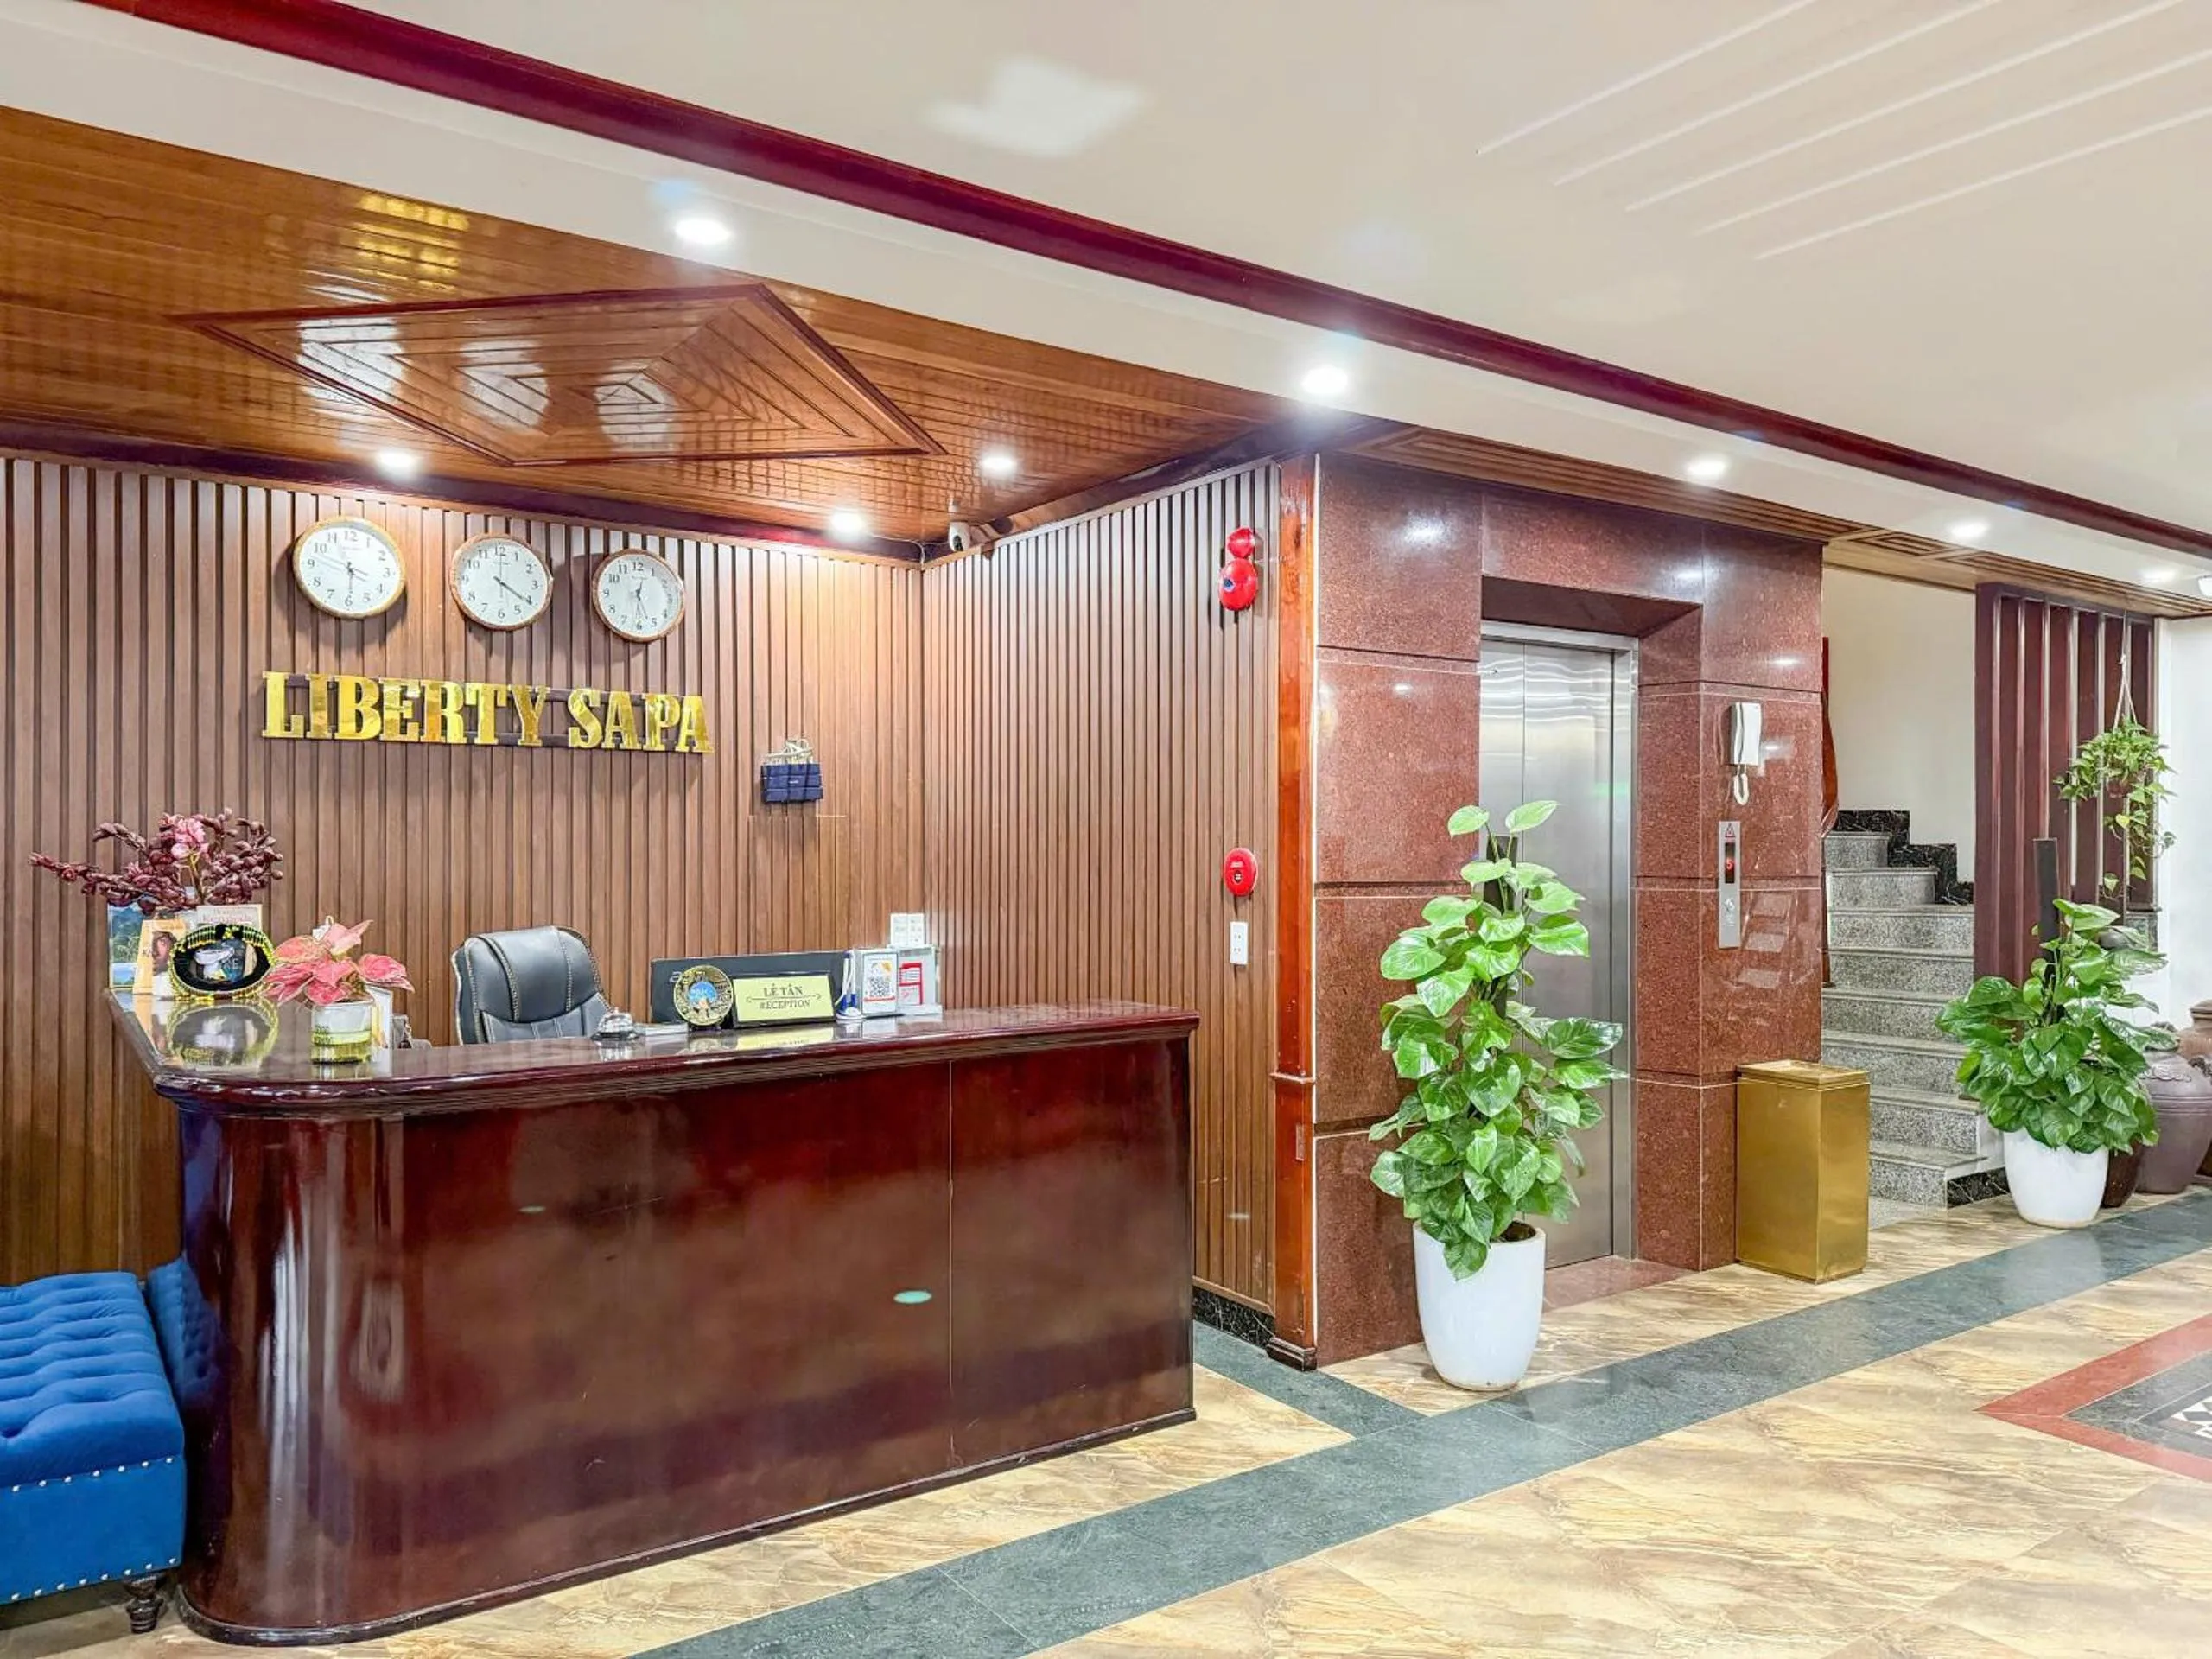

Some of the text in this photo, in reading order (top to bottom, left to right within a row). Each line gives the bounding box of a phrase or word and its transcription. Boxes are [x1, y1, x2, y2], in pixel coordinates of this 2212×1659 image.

[327, 532, 337, 543] 11
[344, 531, 358, 542] 12
[315, 542, 327, 553] 10
[495, 546, 506, 556] 12
[378, 550, 386, 561] 2
[479, 550, 488, 559] 11
[307, 559, 315, 569] 9
[467, 559, 480, 569] 10
[525, 563, 533, 574] 2
[619, 564, 627, 574] 11
[632, 562, 644, 571] 12
[382, 568, 391, 578] 3
[313, 577, 321, 587] 8
[608, 574, 620, 583] 10
[532, 580, 538, 590] 3
[327, 589, 335, 599] 7
[468, 591, 475, 601] 8
[603, 588, 609, 597] 9
[345, 595, 353, 607] 6
[481, 602, 488, 613] 7
[514, 605, 521, 614] 5
[609, 604, 615, 613] 8
[498, 609, 505, 619] 6
[620, 615, 627, 625] 7
[636, 620, 642, 630] 6
[651, 618, 657, 627] 5
[262, 671, 714, 754] LIBERTY SAPA
[760, 999, 810, 1010] RECEPTION
